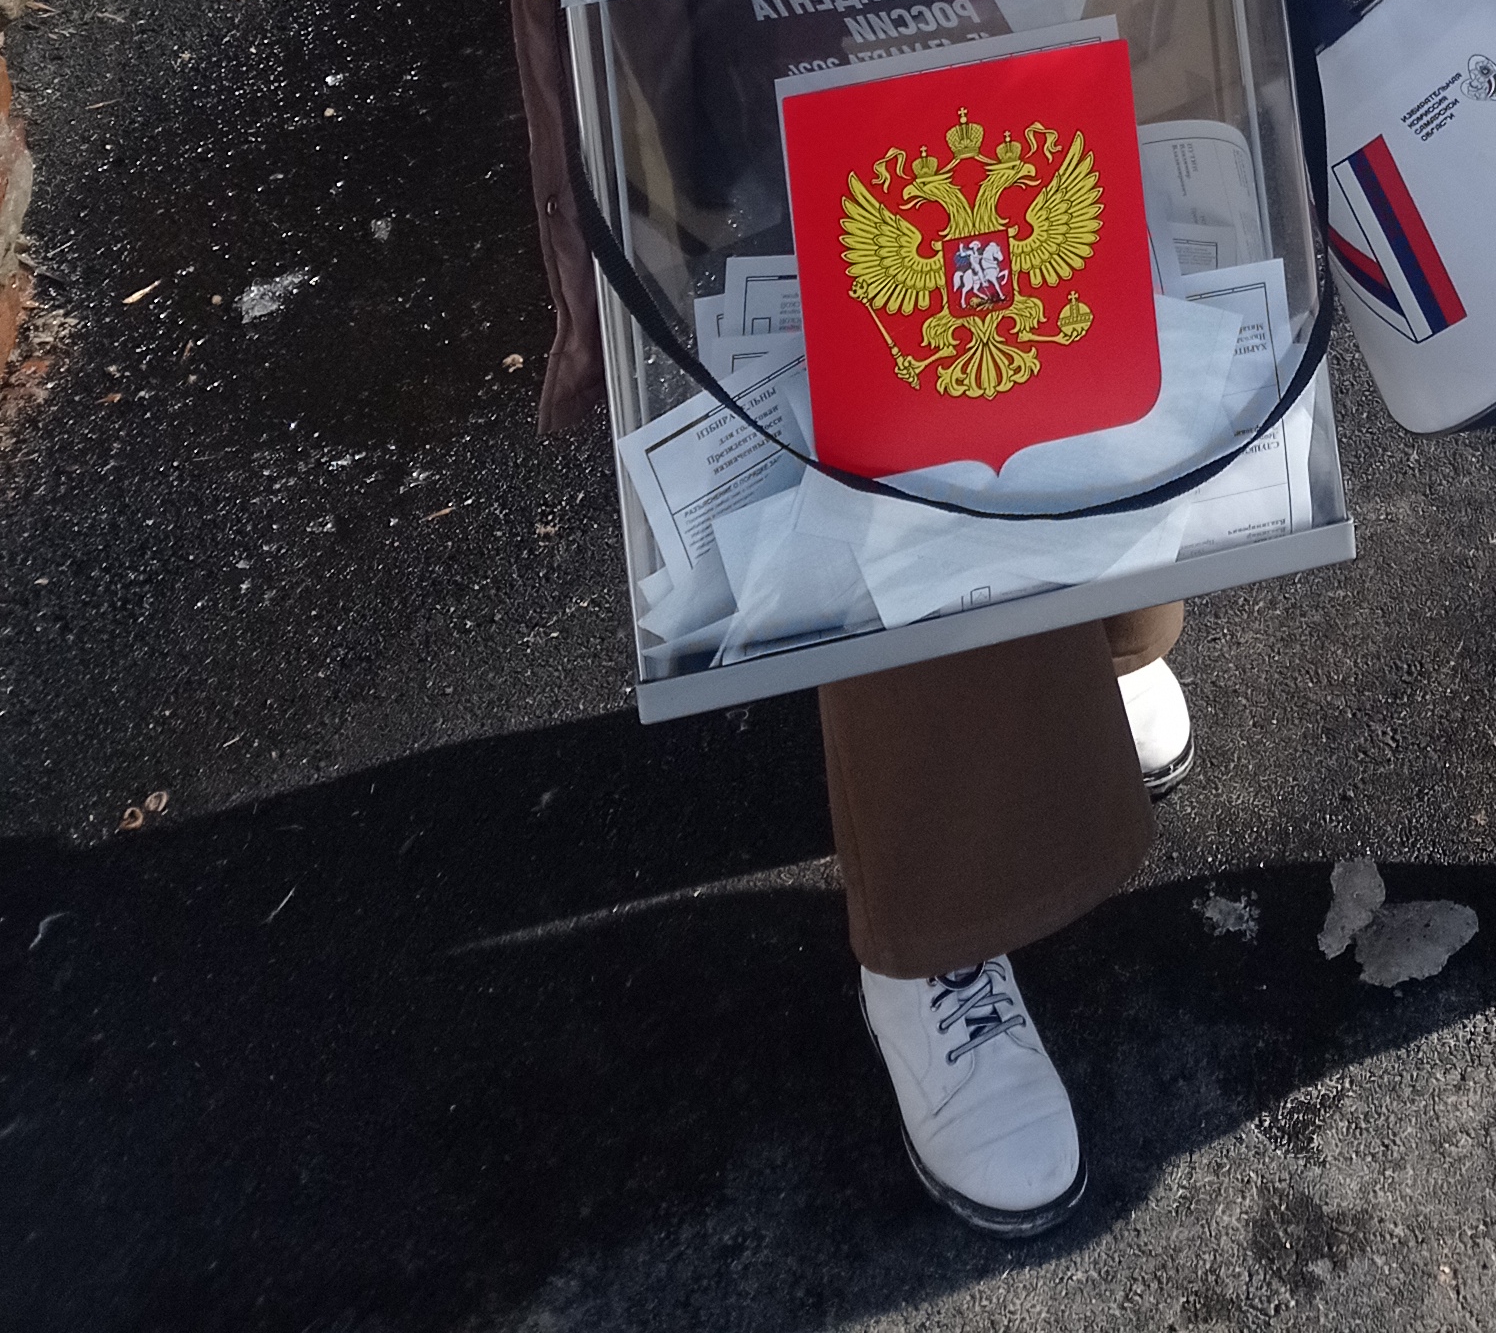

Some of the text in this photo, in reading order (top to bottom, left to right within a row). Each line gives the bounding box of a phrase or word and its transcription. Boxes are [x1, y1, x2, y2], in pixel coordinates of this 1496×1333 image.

[1401, 72, 1462, 123] ИЗБИРАТЕЛЬНАЯ
[1407, 95, 1448, 129] КОМИССИЯ
[696, 387, 777, 441] ИЗБИРАЕЛЬНЫ
